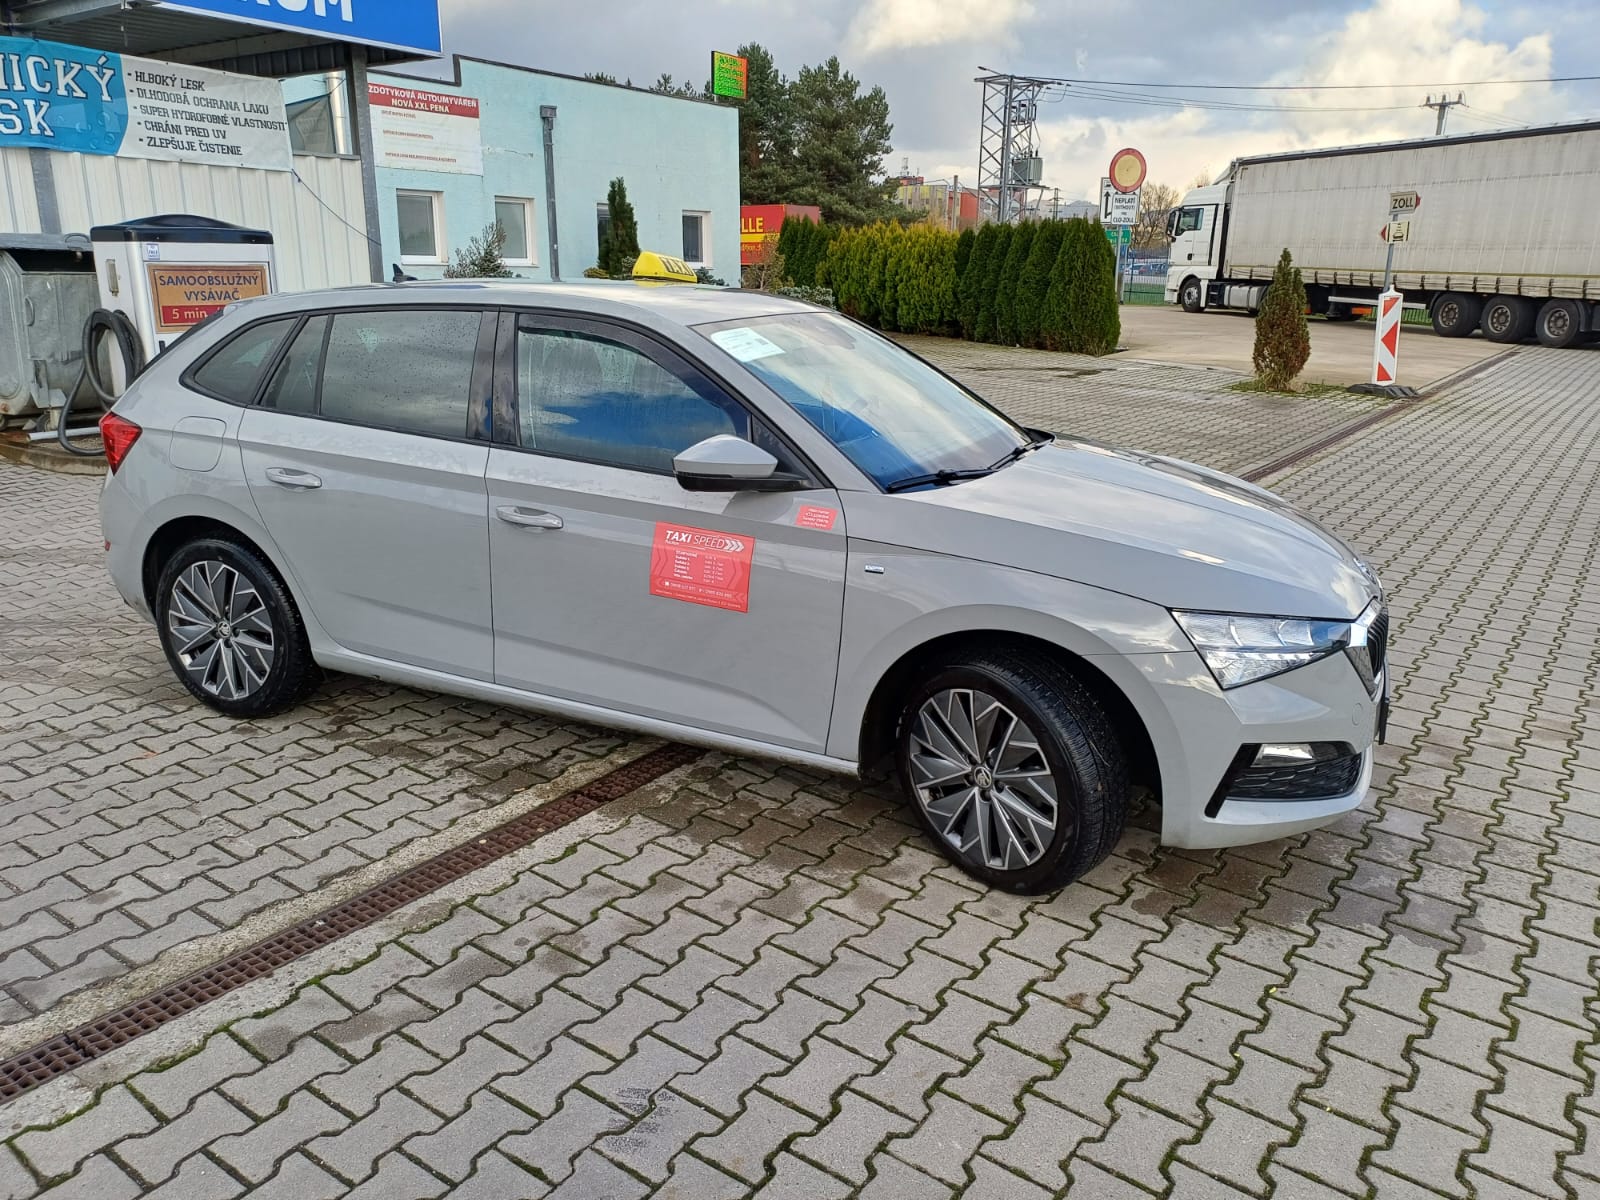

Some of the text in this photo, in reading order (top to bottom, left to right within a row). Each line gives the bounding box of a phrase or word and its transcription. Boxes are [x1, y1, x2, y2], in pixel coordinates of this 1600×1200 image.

[135, 70, 205, 92] HLBOKÝ LESK
[136, 87, 269, 115] DLHODOBÁ OCHRANA LAKU
[415, 100, 429, 110] XXL
[430, 103, 450, 113] PENA
[139, 104, 285, 131] SUPER HYDROFOBNÉ VLASTNOSTI
[144, 119, 227, 139] CHRÁNI PRED UV
[147, 136, 243, 156] ZLEPŠUJE ČISTENIE
[1392, 197, 1414, 209] ZOLL
[659, 255, 694, 276] TAXI
[159, 272, 259, 286] SAMOOBSLUŽNÝ
[184, 287, 240, 301] VYSÁVAČ
[172, 308, 180, 320] 5
[665, 530, 692, 544] TAXI
[693, 534, 725, 549] SPEED
